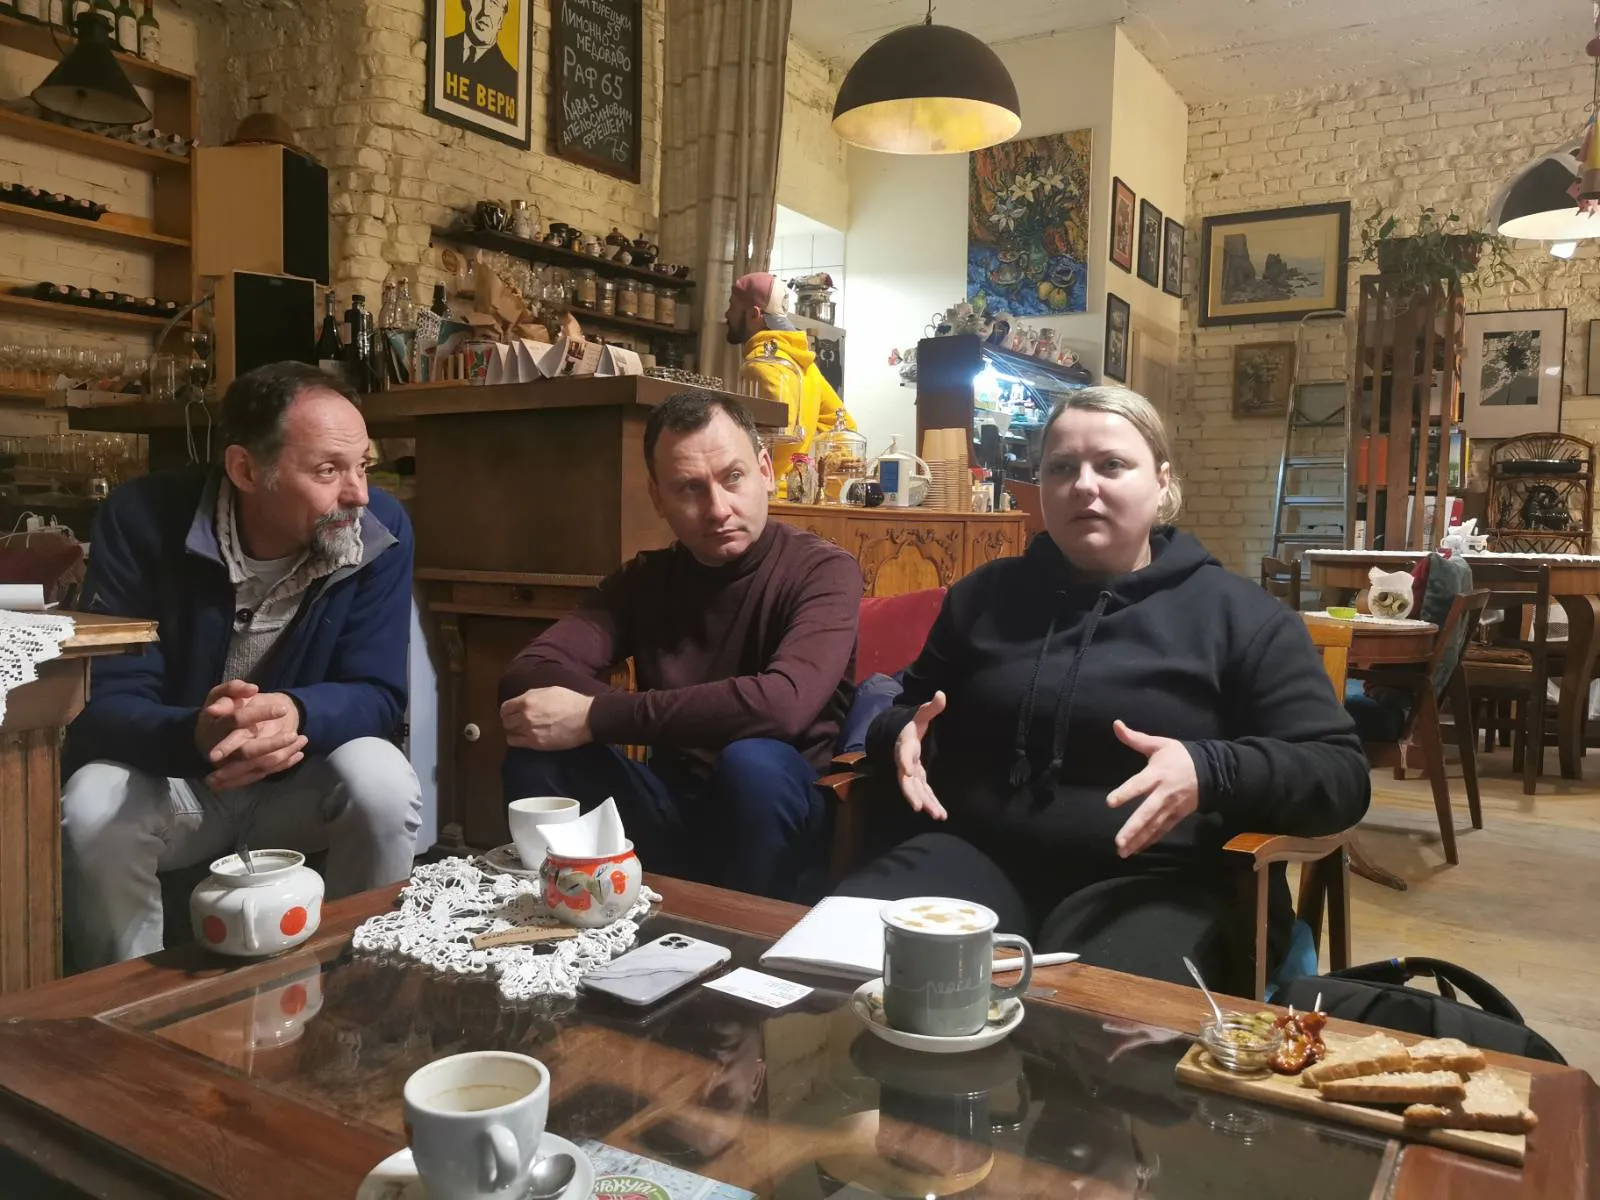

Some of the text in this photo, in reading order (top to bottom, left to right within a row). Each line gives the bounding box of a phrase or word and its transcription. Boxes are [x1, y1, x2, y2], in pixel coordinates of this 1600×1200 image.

[562, 45, 623, 100] РАФ 65
[446, 71, 515, 120] НЕ ВЕРЮ
[562, 90, 591, 121] КАВА
[583, 118, 625, 149] ФРЕШЕМ
